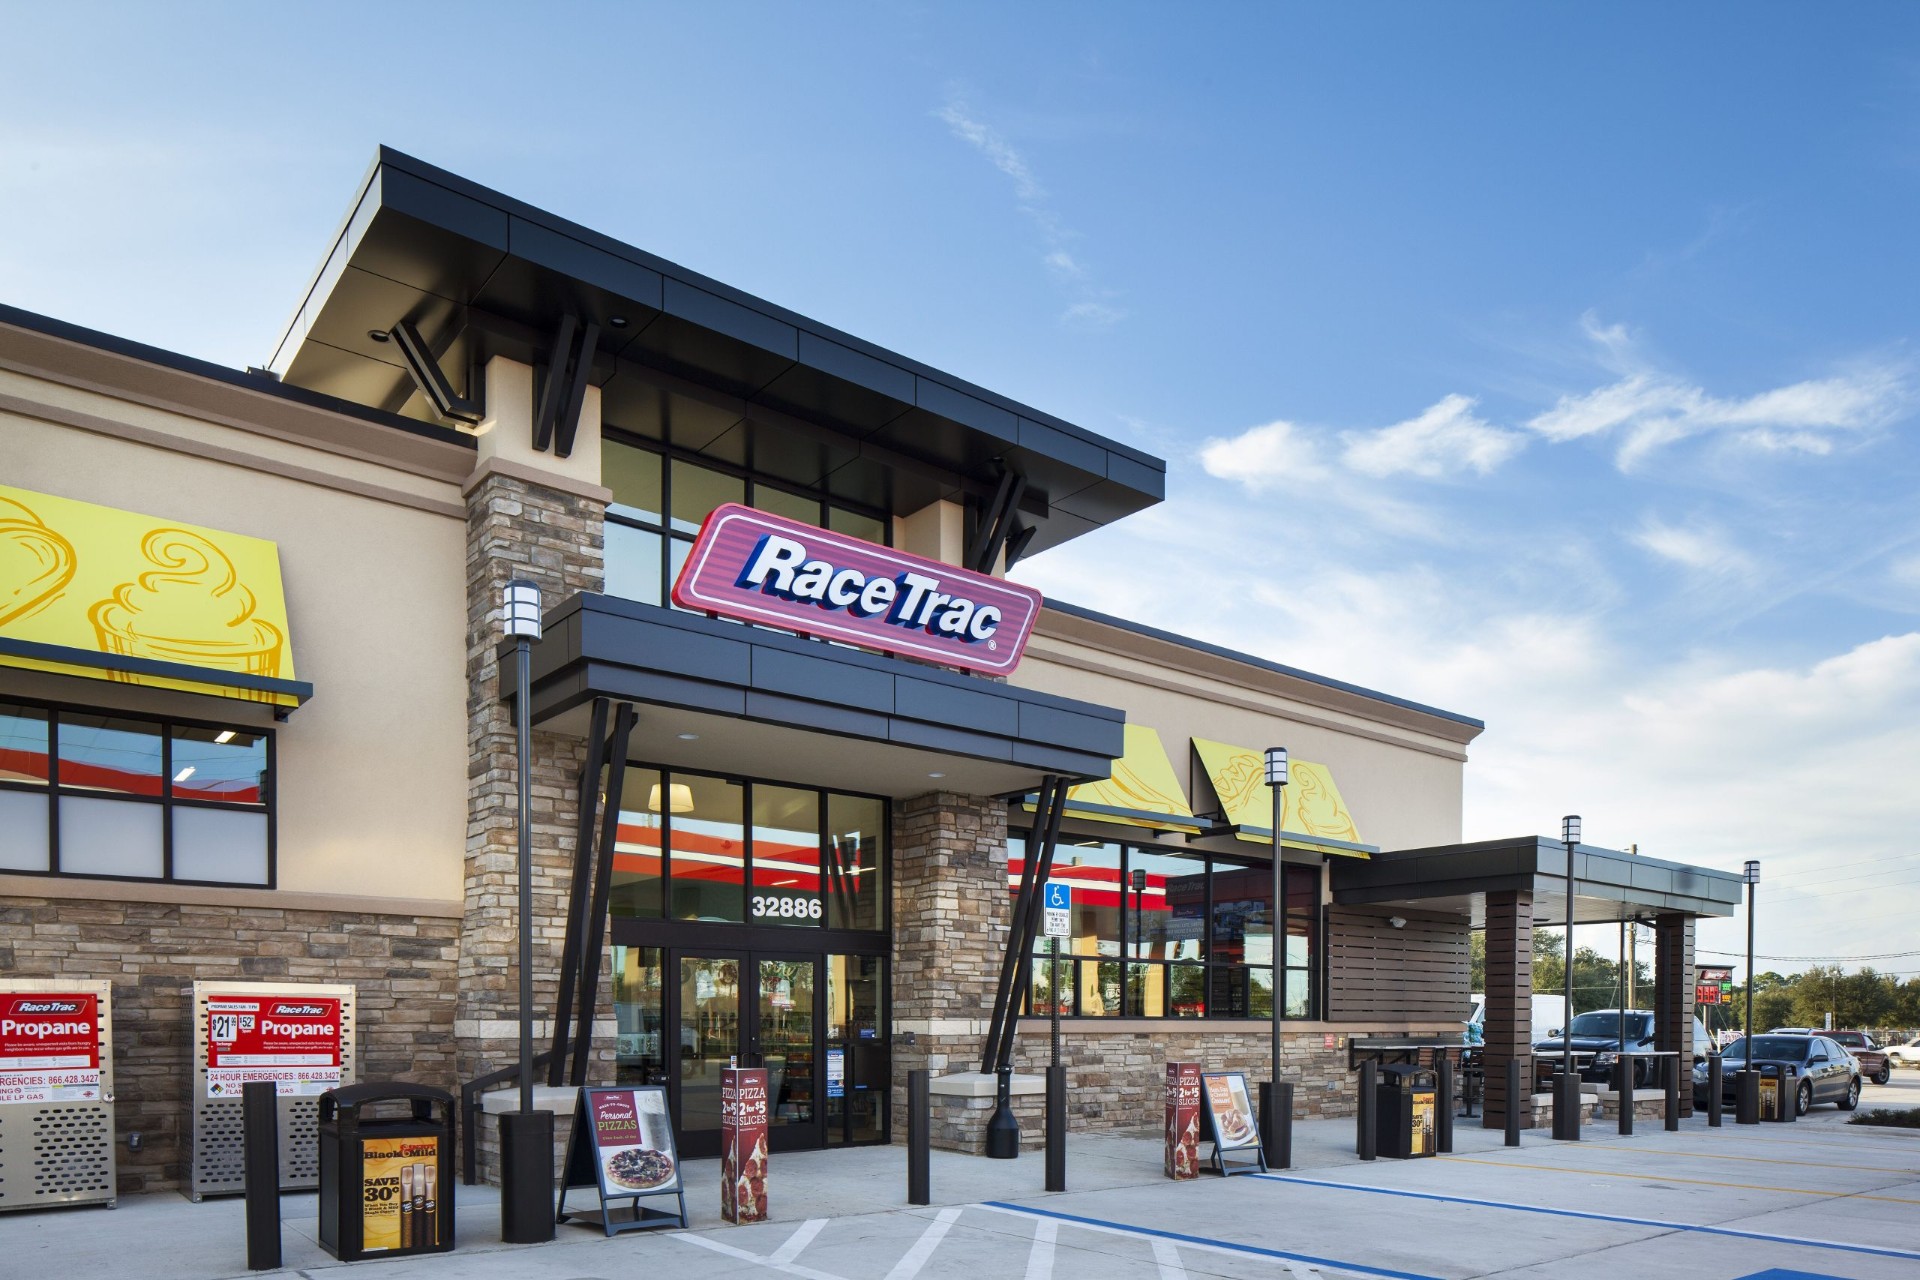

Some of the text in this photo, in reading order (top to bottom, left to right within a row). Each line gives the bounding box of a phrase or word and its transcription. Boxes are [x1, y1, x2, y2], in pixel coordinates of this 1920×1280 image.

[735, 533, 1003, 641] RaceTrac
[752, 896, 822, 919] 32886
[19, 1003, 76, 1012] RaceTrac
[276, 1005, 323, 1014] RaceTrac
[2, 1020, 90, 1039] Propane
[261, 1020, 334, 1038] Propane
[48, 1075, 98, 1084] 866.428.3427
[220, 1073, 241, 1081] HOUR
[243, 1072, 296, 1080] EMERGENCIES:
[298, 1072, 339, 1080] 866.428.3427
[1179, 1076, 1200, 1086] PIZZA
[739, 1087, 767, 1100] PIZZA
[1179, 1088, 1185, 1098] 2
[1191, 1087, 1199, 1098] $5
[1179, 1098, 1200, 1106] SLICES
[740, 1101, 766, 1116] 2 for $5
[600, 1110, 633, 1120] Personal
[598, 1120, 637, 1131] PIZZAS
[739, 1115, 767, 1126] SLICES
[364, 1150, 403, 1159] Black
[410, 1149, 436, 1157] Mild
[365, 1177, 399, 1186] SAVE
